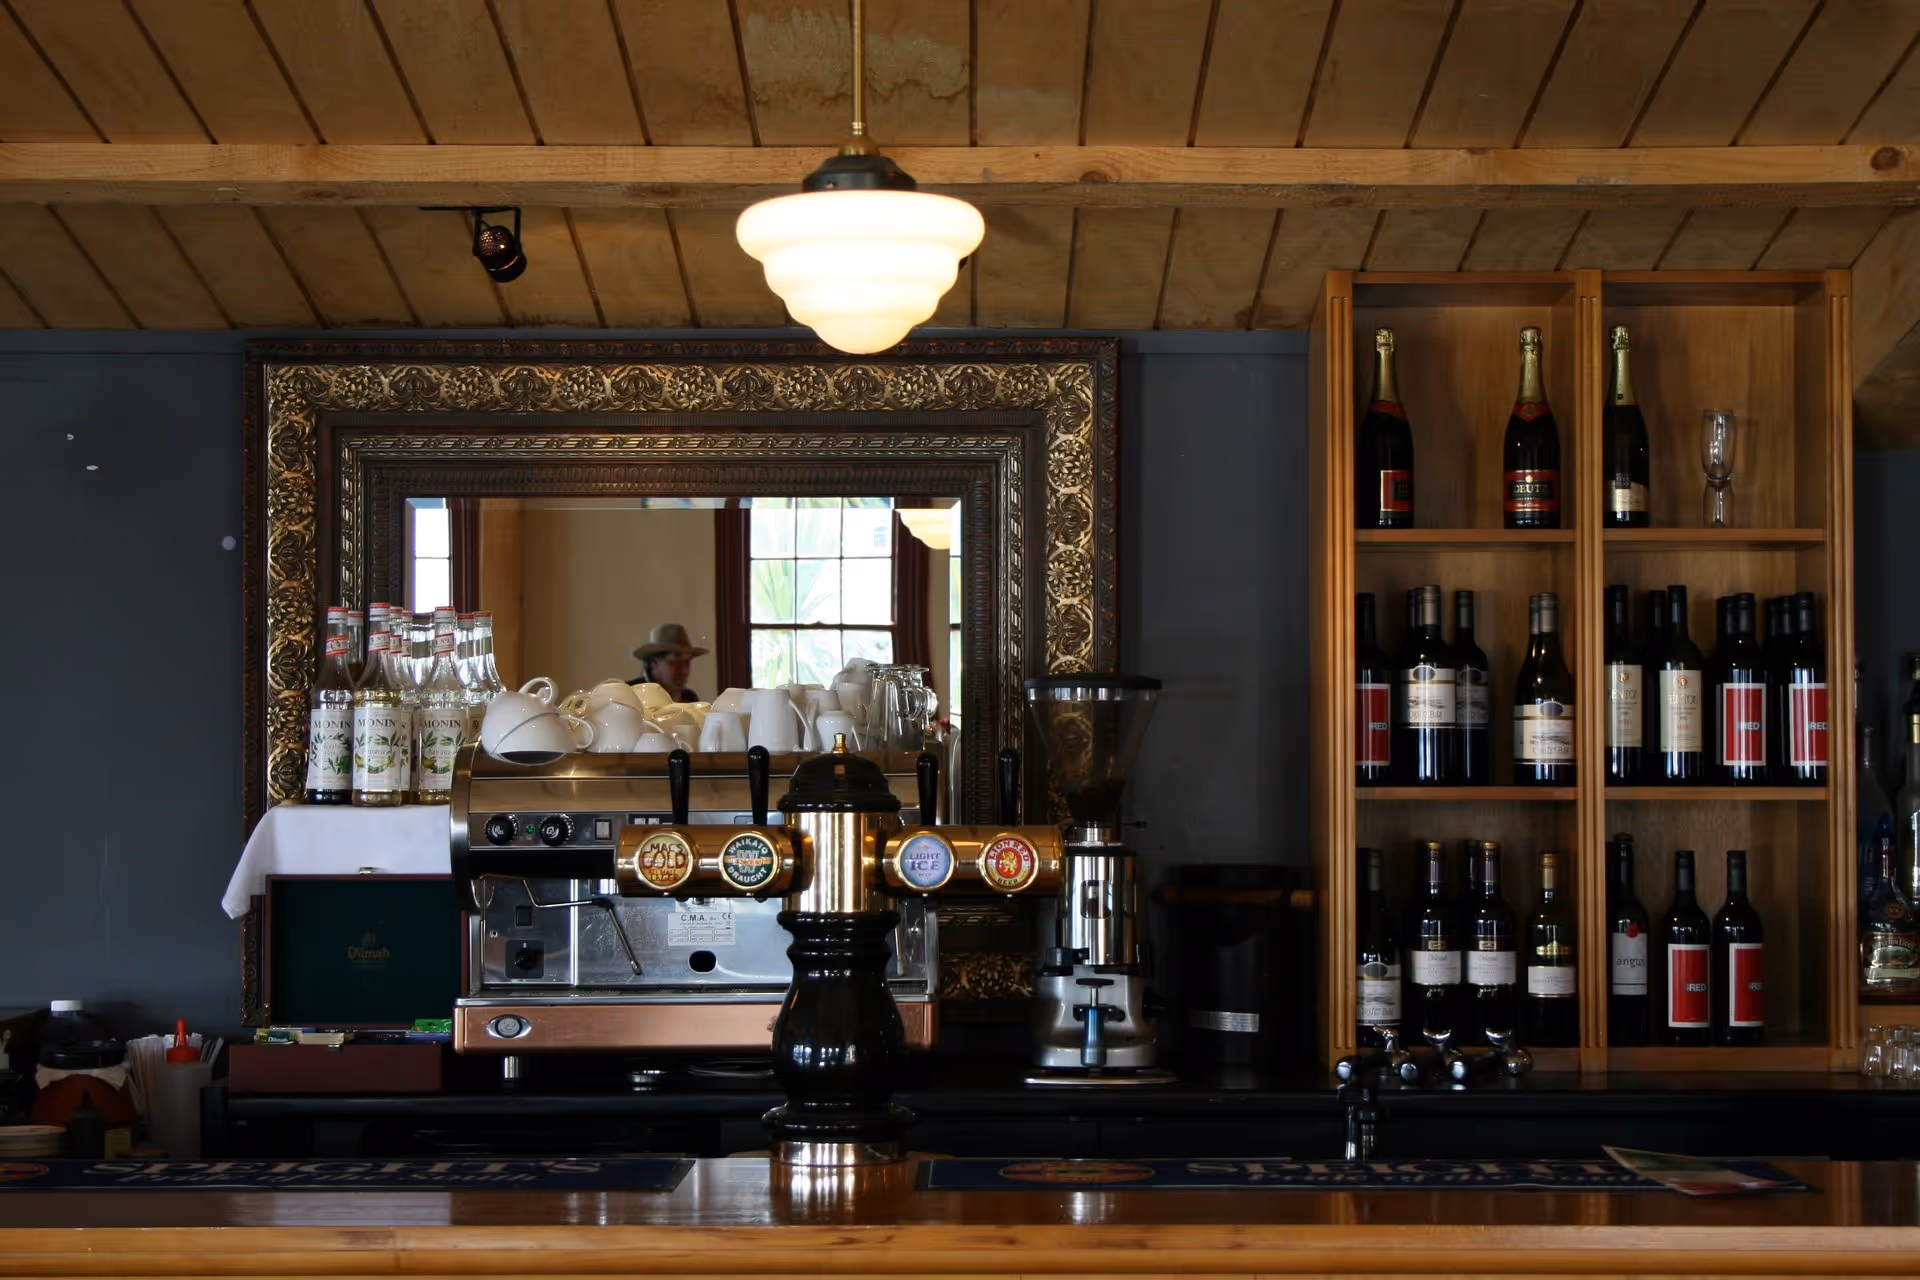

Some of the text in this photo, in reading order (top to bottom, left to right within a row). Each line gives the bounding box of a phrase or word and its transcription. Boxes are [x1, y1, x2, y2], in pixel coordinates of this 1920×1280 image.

[314, 719, 351, 729] MONIN
[358, 718, 397, 728] MONIN
[424, 719, 461, 728] MONIN
[728, 838, 769, 854] WAIKATO
[988, 840, 1030, 862] LION RED
[641, 851, 687, 869] GOLD
[909, 852, 941, 860] LIGHT
[910, 860, 940, 871] ICE
[727, 865, 767, 883] DRAUGHT
[82, 1161, 603, 1175] SPEIGHT'S
